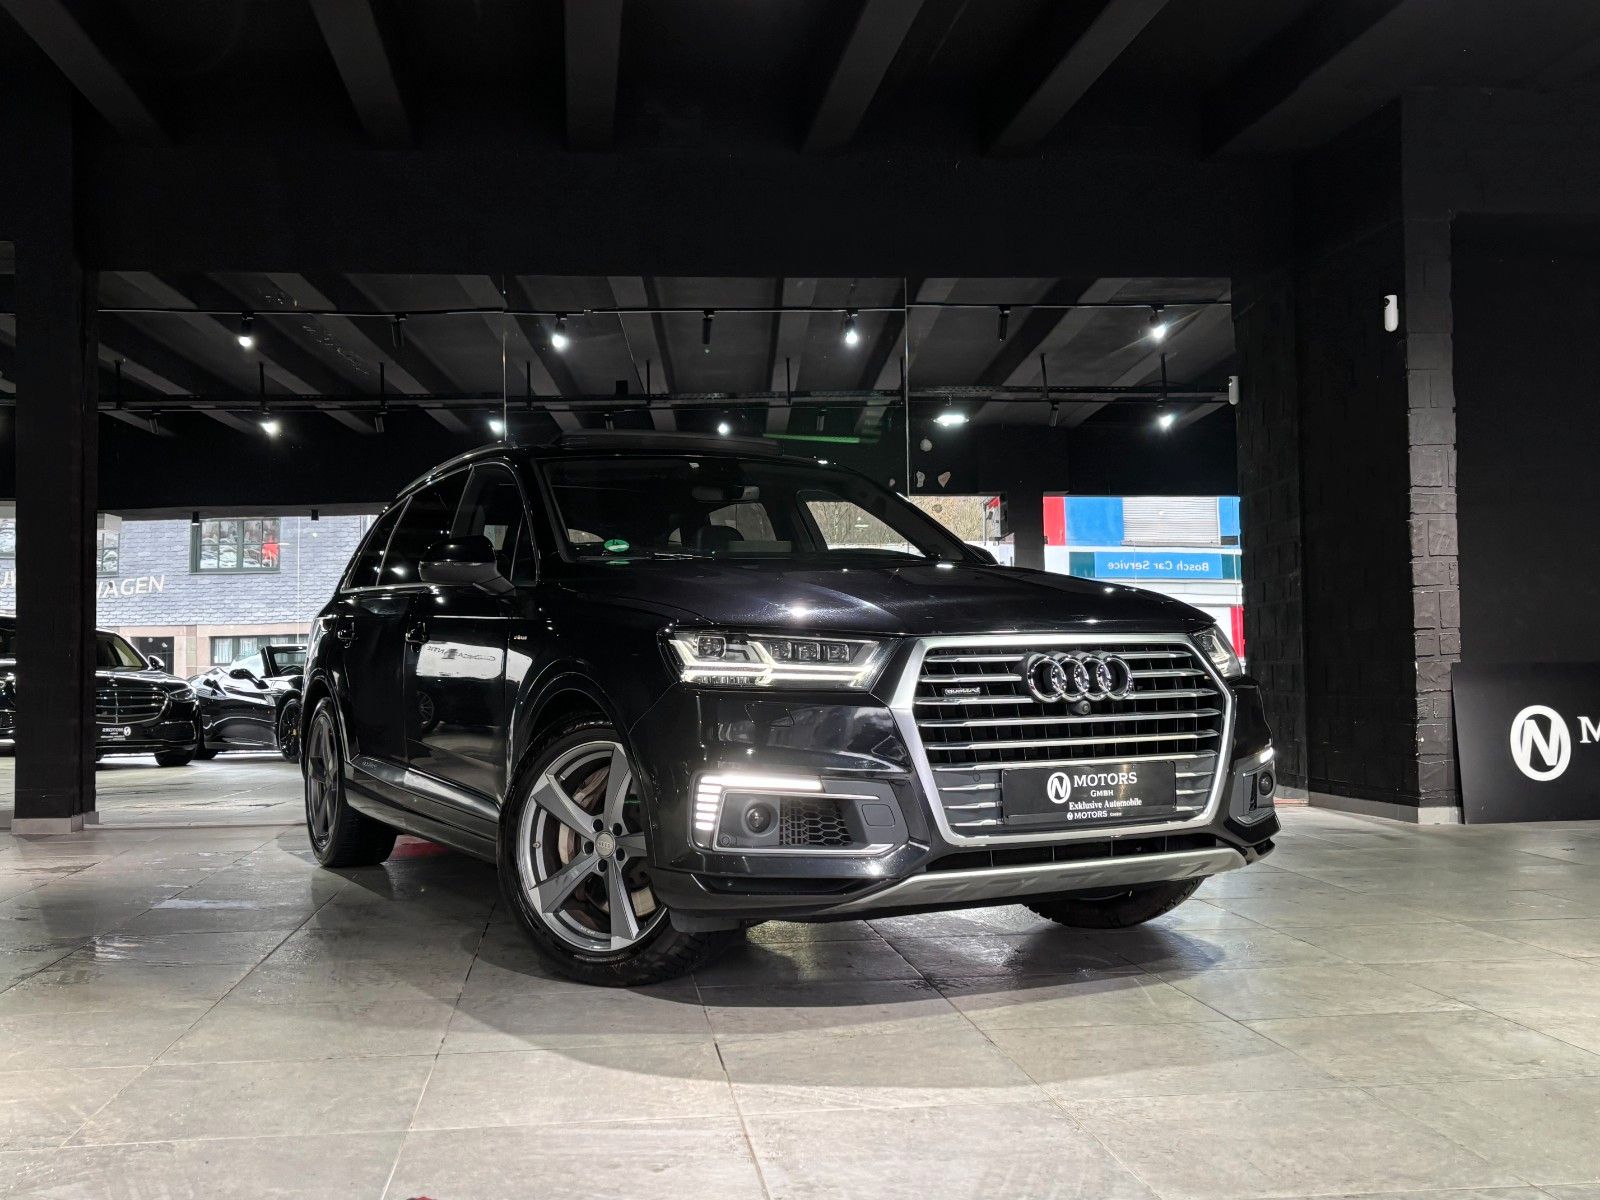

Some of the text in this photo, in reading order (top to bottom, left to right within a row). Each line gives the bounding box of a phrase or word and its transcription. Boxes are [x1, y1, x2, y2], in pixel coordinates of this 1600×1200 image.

[97, 574, 165, 598] AGEN
[1073, 771, 1138, 788] MOTORS
[1069, 797, 1143, 811] Exklusive Automobile
[1074, 810, 1108, 820] MOTORS
